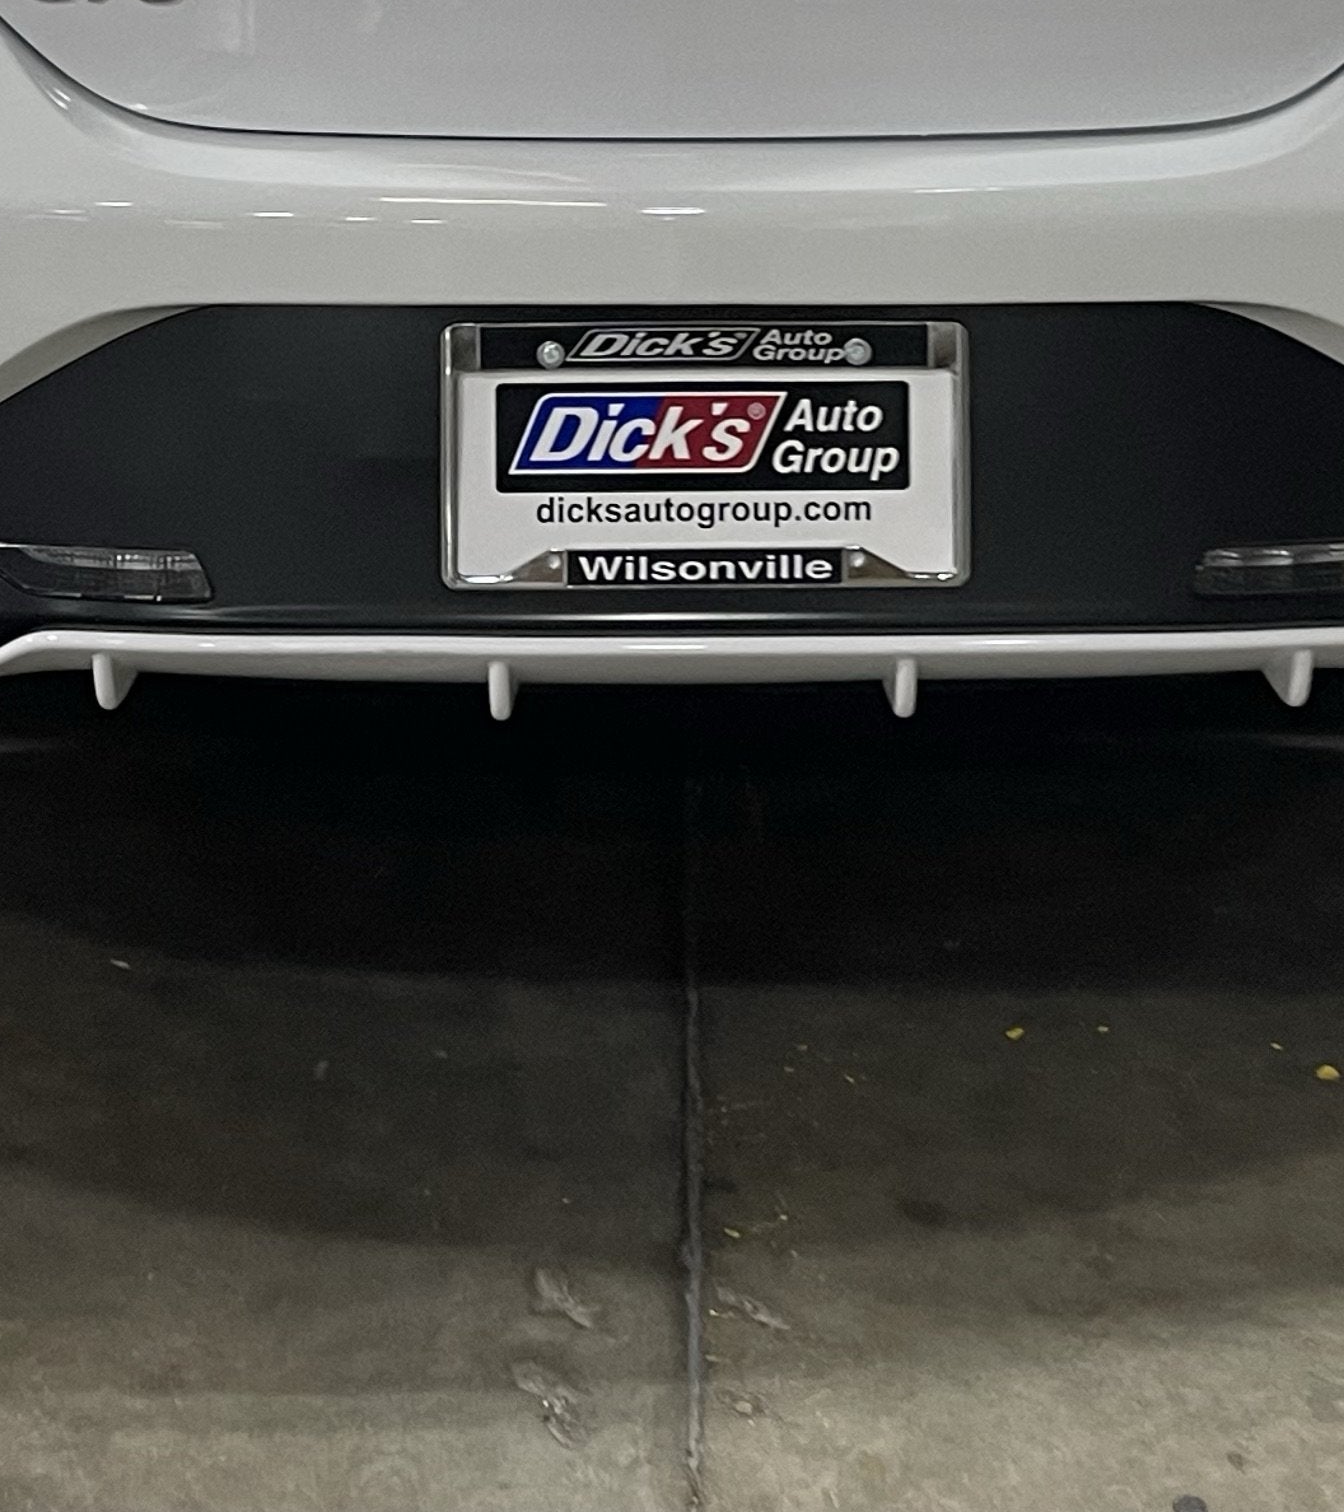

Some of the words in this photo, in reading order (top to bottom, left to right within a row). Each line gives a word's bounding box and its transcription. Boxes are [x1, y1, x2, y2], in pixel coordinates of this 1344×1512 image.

[760, 329, 832, 345] Auto
[752, 344, 847, 364] Group
[784, 398, 884, 433] Auto
[772, 440, 900, 482] Group
[536, 497, 872, 529] dicksautogroup.com
[578, 554, 833, 581] Wilsonville
